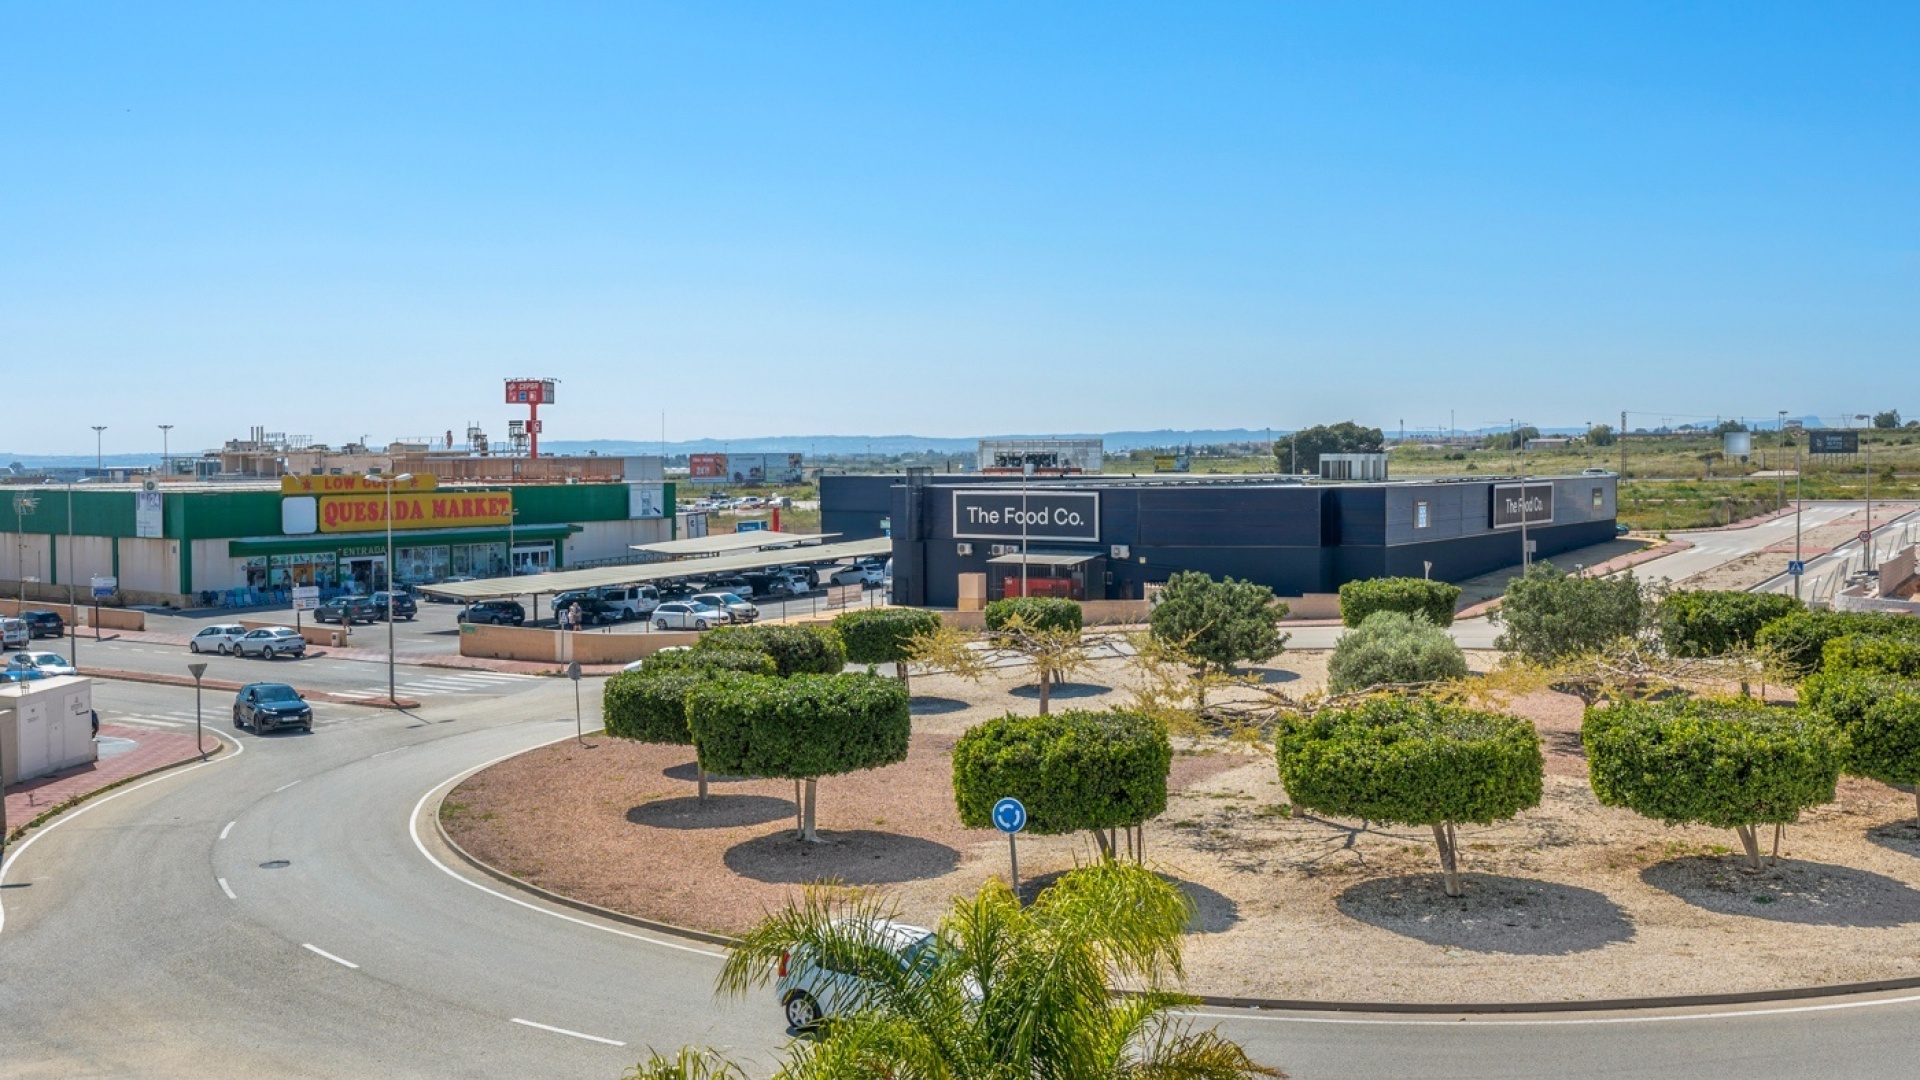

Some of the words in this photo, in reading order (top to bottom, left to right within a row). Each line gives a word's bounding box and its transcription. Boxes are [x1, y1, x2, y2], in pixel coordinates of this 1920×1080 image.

[324, 477, 355, 490] LOW
[324, 501, 424, 527] QUESADA
[432, 498, 509, 518] MARKET
[1505, 497, 1517, 513] The
[967, 506, 999, 524] The
[1004, 506, 1048, 525] Food
[1054, 507, 1084, 526] Co.
[342, 546, 387, 557] ENTRADA
